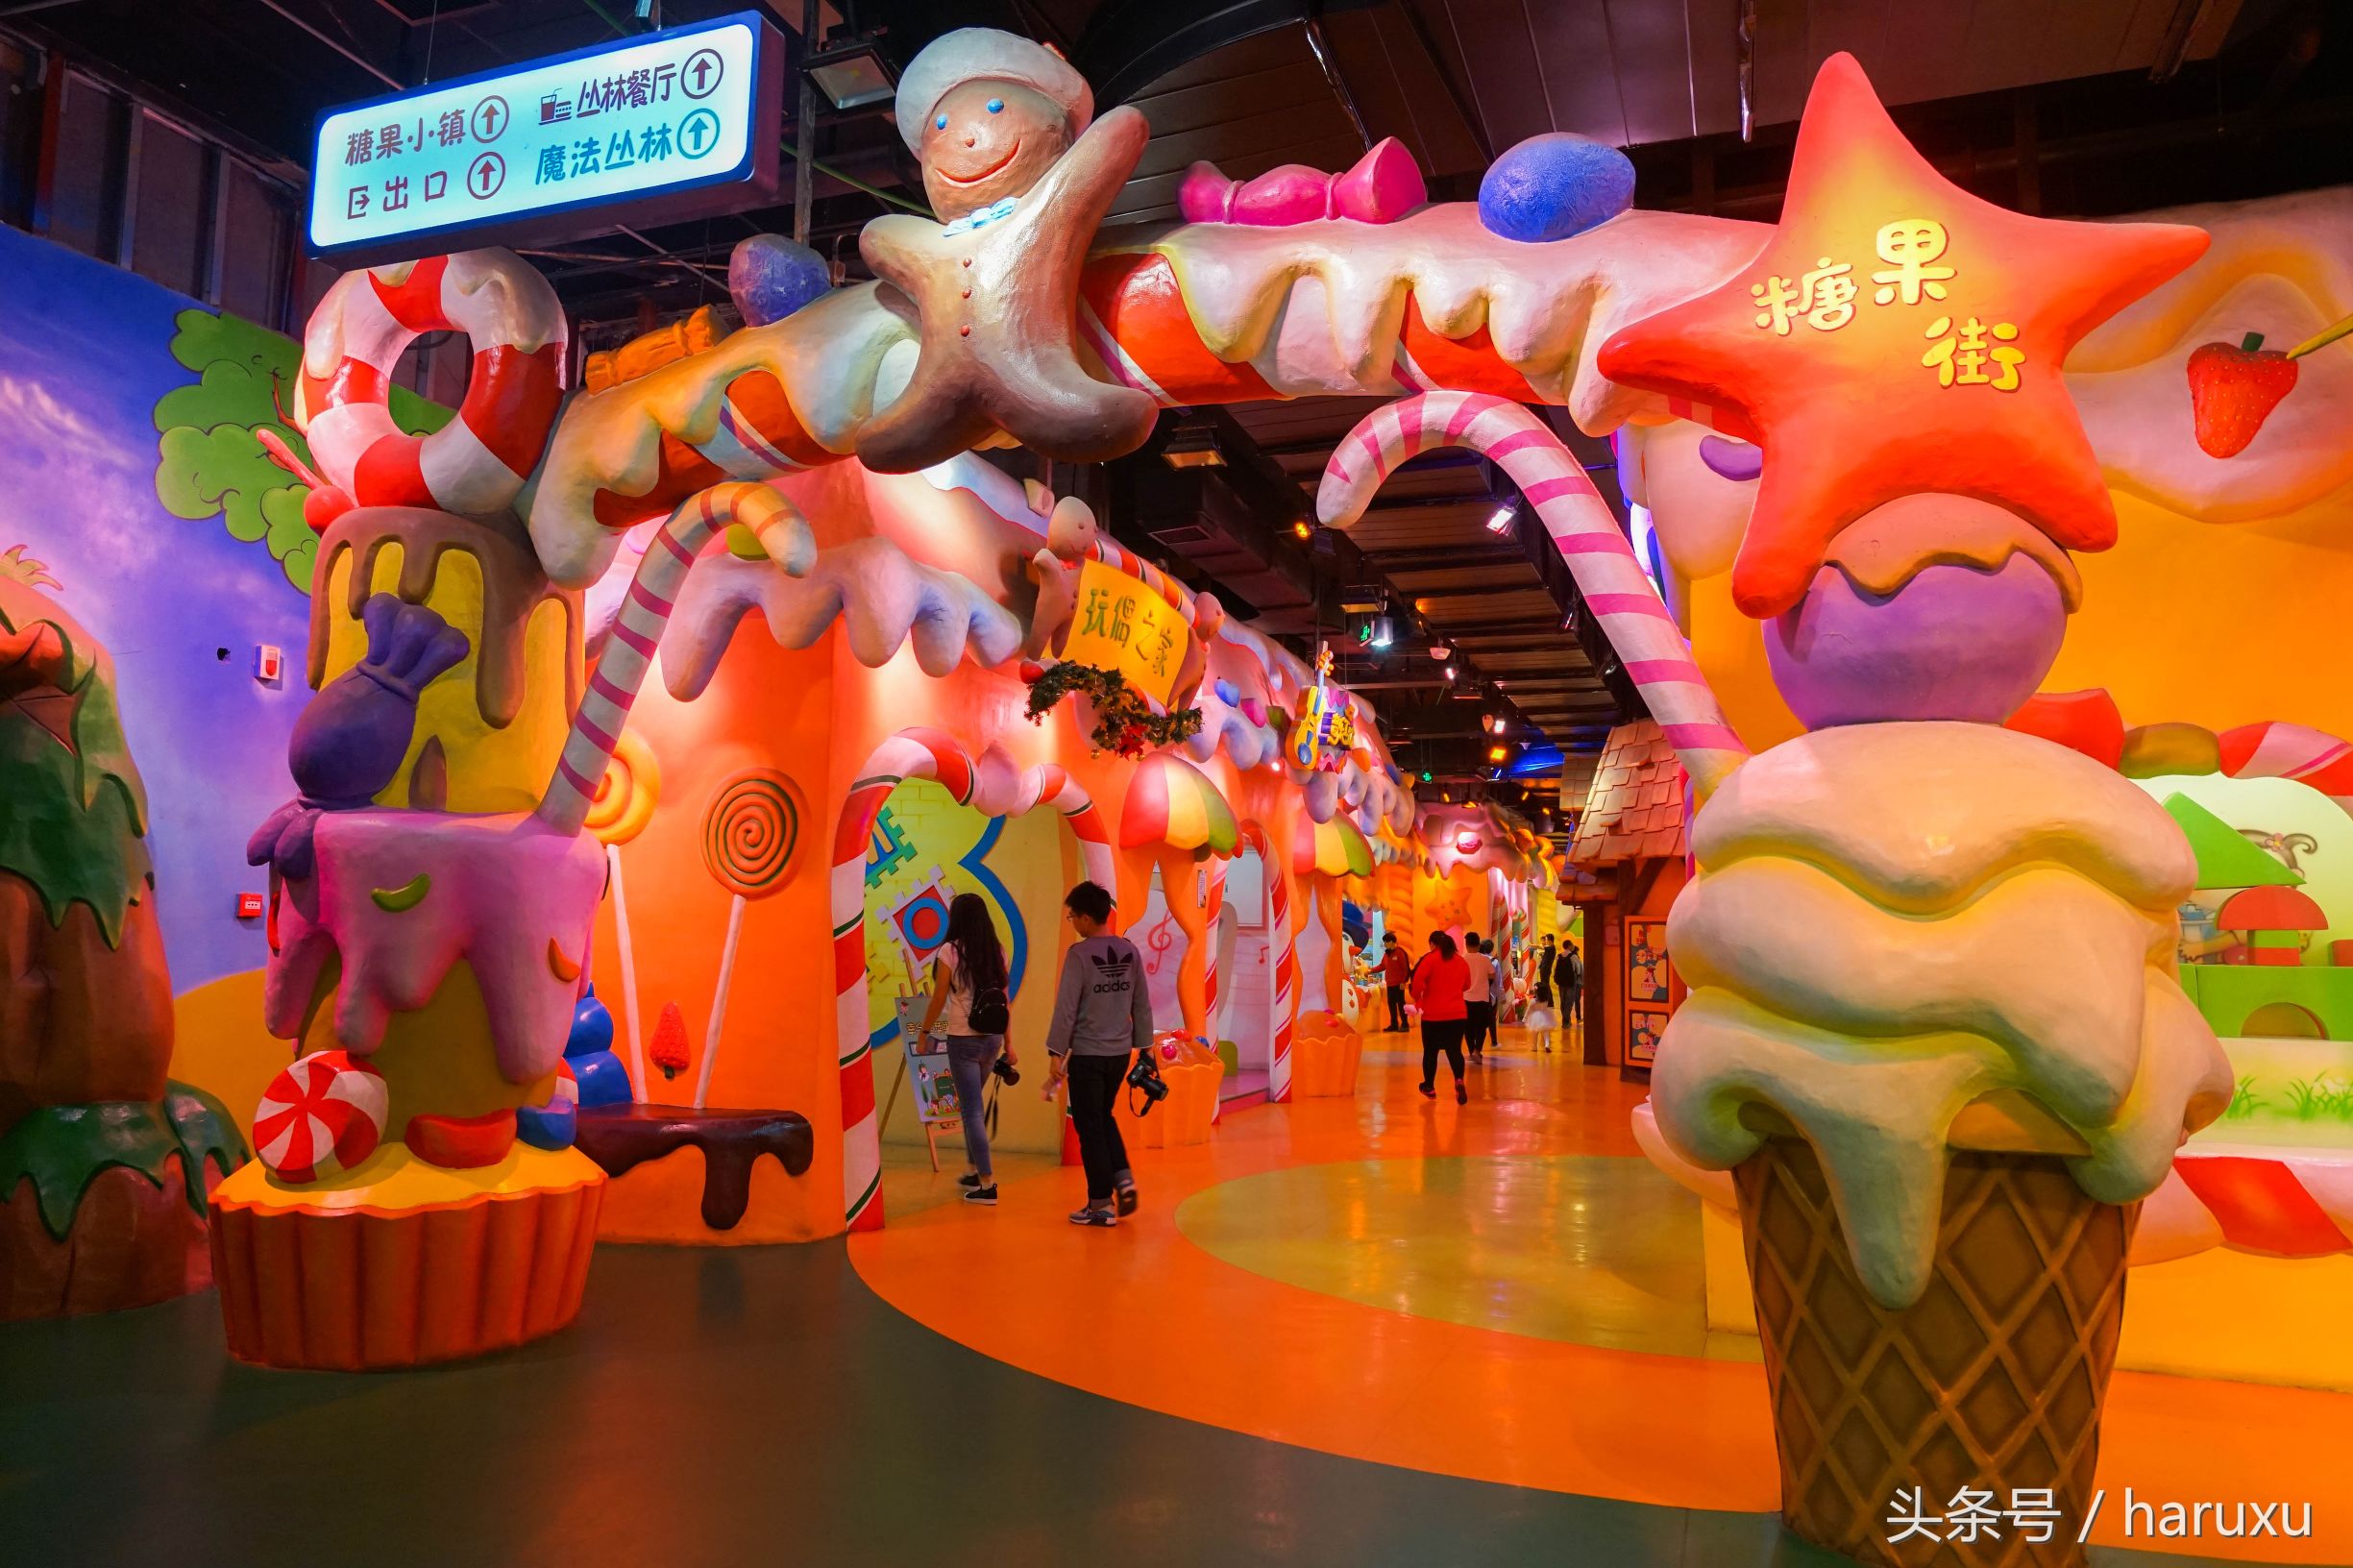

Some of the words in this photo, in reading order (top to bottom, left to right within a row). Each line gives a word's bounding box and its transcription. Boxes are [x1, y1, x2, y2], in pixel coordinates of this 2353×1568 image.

[576, 63, 676, 118] 丛林餐厅
[344, 109, 466, 165] 糖果小镇
[534, 122, 673, 186] 魔法丛林
[381, 170, 448, 213] 出口
[1751, 219, 2025, 392] 糖果街
[1081, 588, 1174, 677] 玩偶之家
